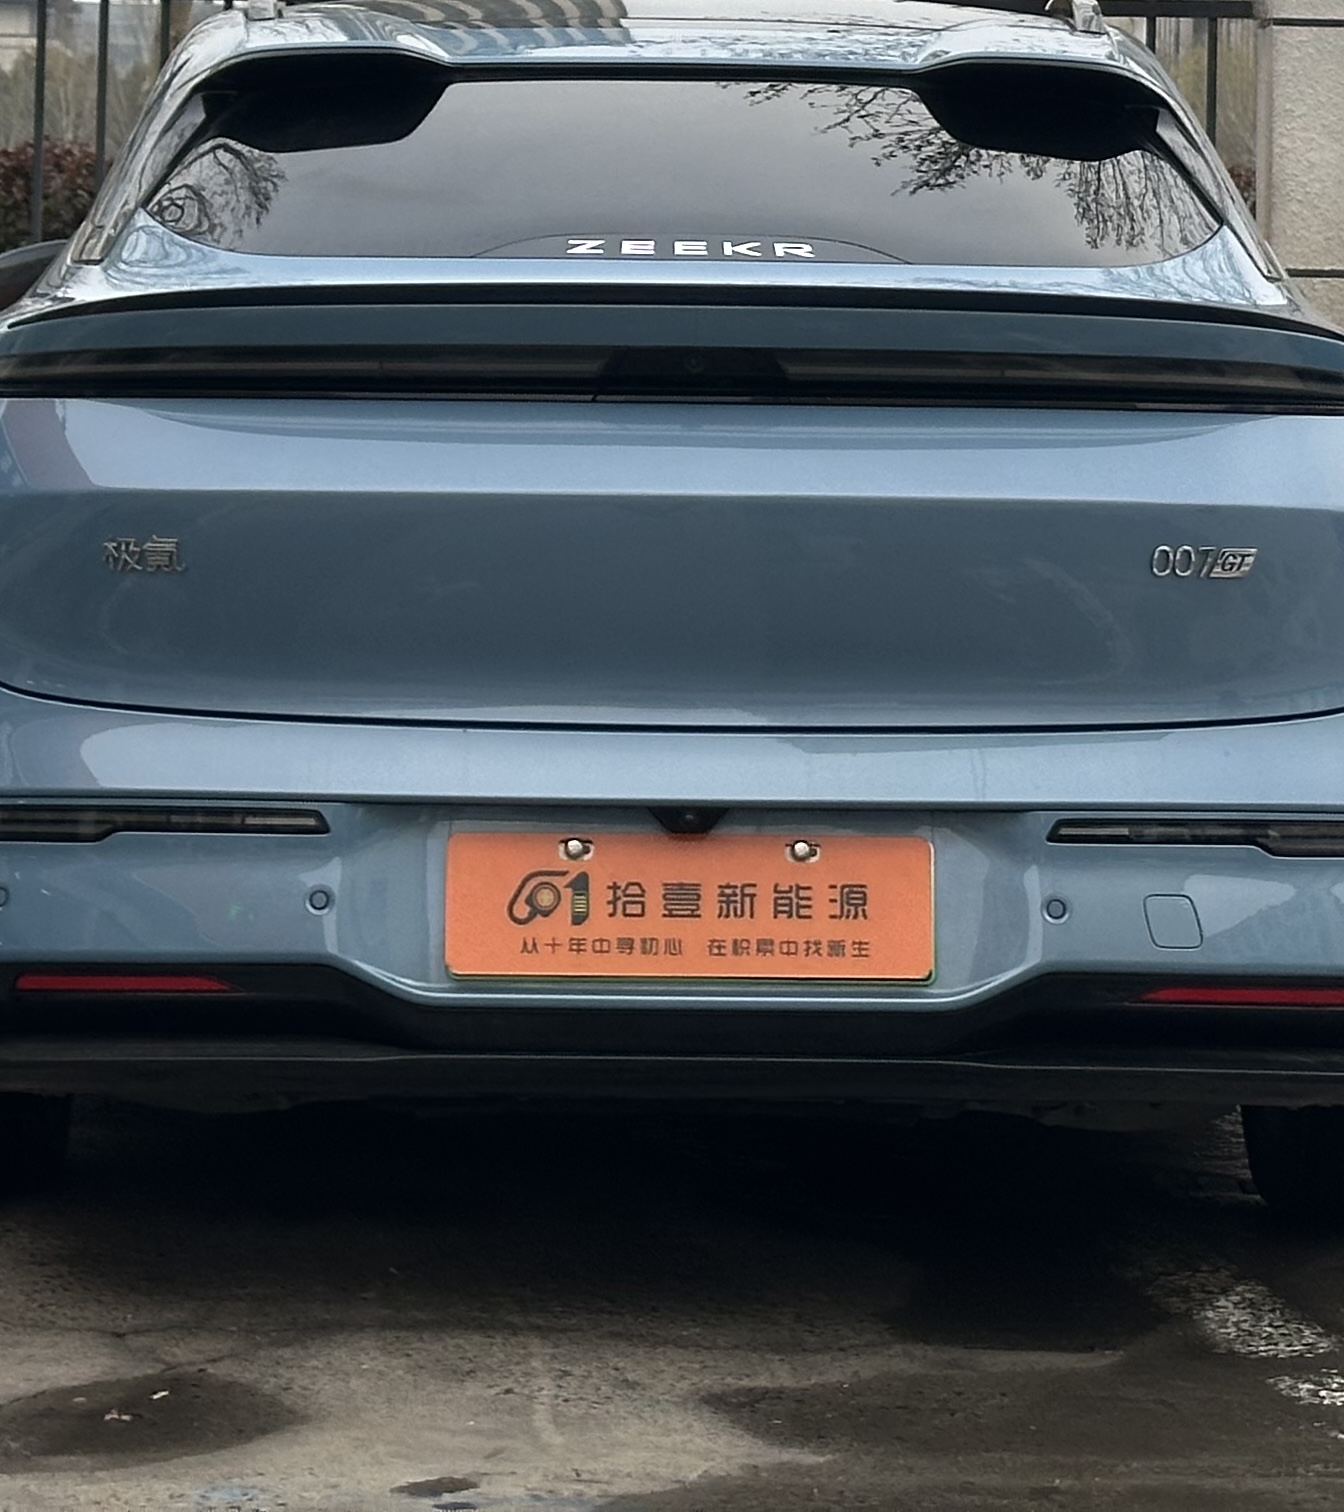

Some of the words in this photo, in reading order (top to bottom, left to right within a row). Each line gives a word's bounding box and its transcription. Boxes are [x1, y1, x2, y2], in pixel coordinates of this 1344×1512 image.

[566, 239, 815, 257] ZEEKR
[606, 881, 869, 920] 拾壹新能源
[519, 937, 684, 956] 从十年中寻初心
